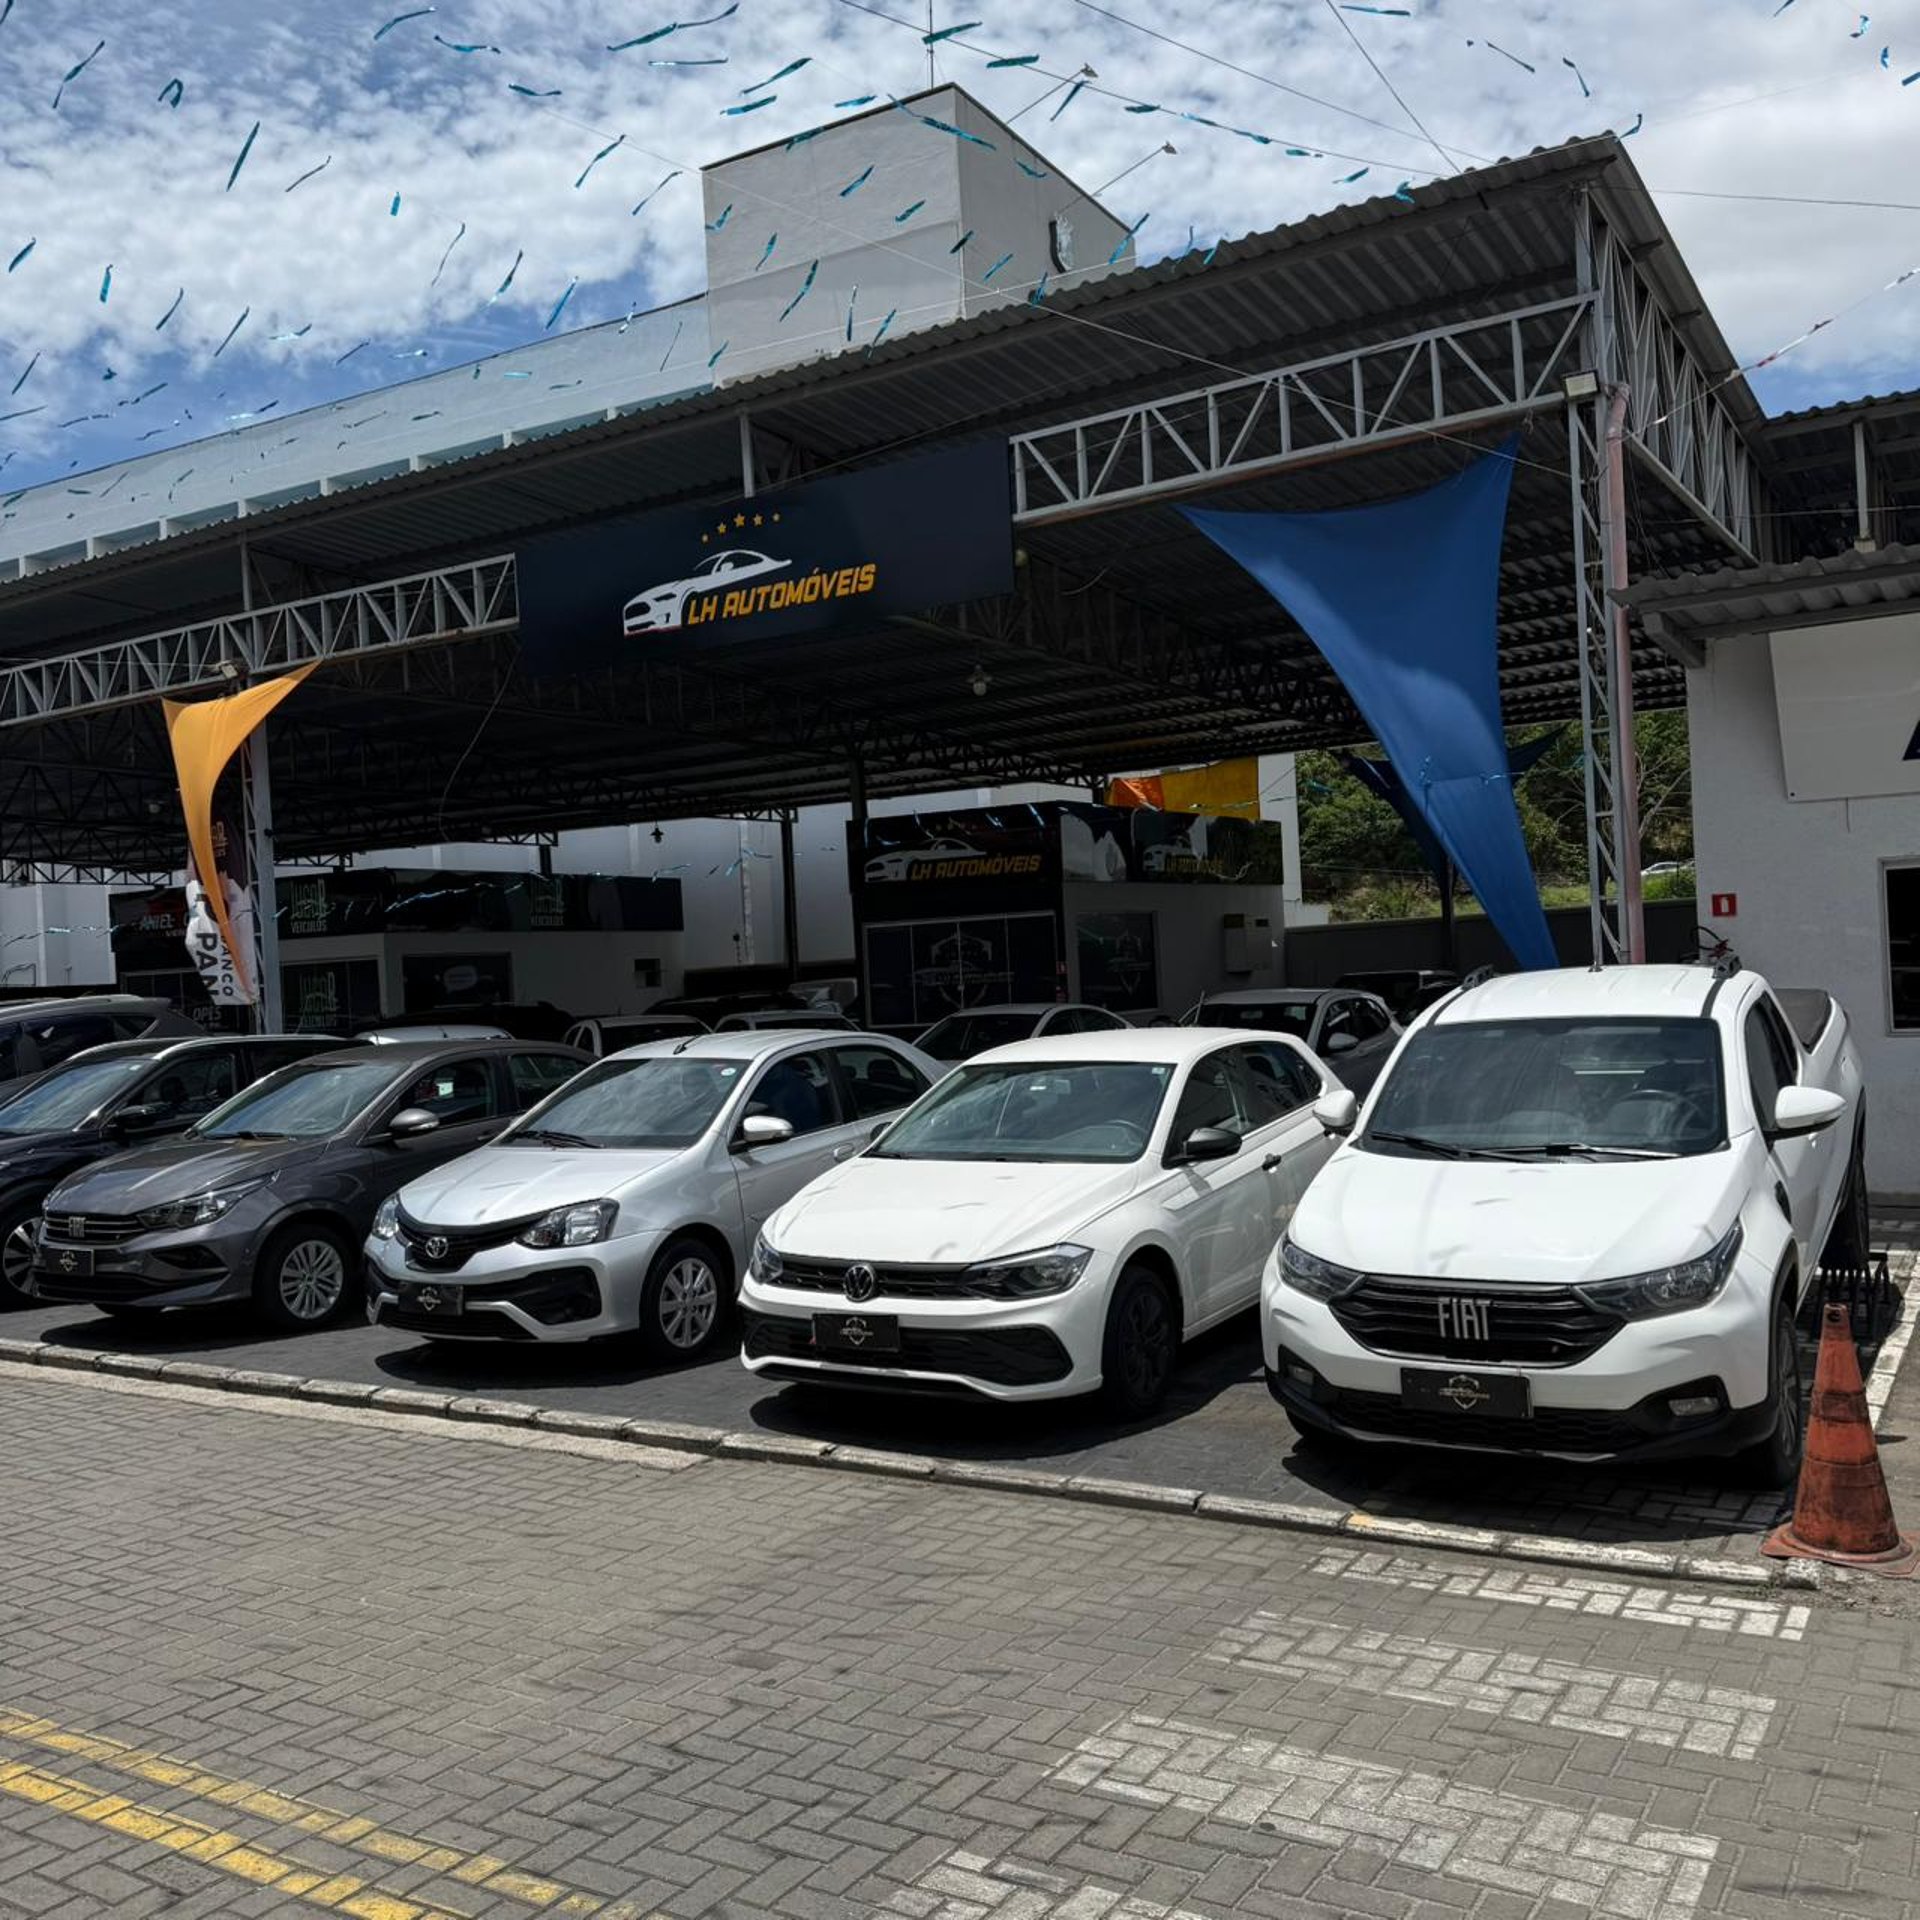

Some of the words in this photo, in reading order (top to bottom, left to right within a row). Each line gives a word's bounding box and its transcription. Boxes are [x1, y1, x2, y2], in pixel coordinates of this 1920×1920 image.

[688, 597, 717, 625] LH
[722, 564, 876, 618] AUTOMÓVEIS
[911, 862, 932, 881] LH
[935, 852, 1042, 879] AUTOMÓVEIS
[1438, 1296, 1494, 1341] FIAT
